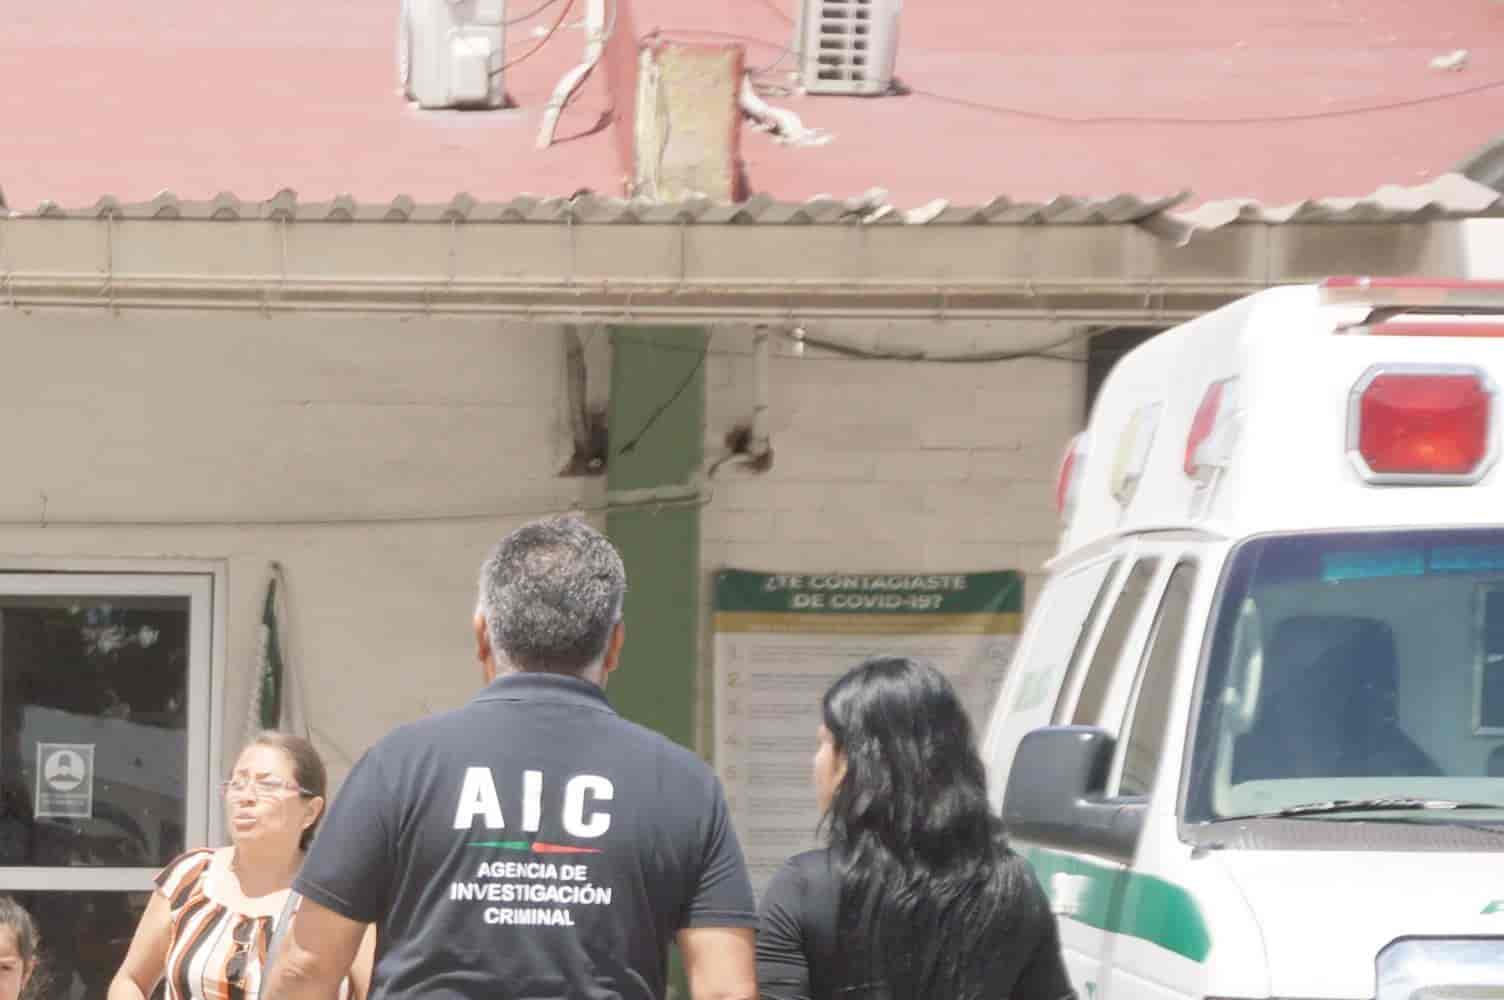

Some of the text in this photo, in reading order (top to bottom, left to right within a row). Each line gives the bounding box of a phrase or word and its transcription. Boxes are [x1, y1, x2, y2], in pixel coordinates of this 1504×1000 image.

[809, 575, 968, 590] CONTAGIASTE
[791, 593, 943, 609] DE COVID-19?
[476, 862, 588, 881] AGENCIA DE
[450, 882, 612, 905] INVESTIGACIÓN
[483, 907, 575, 926] CRIMINAL
